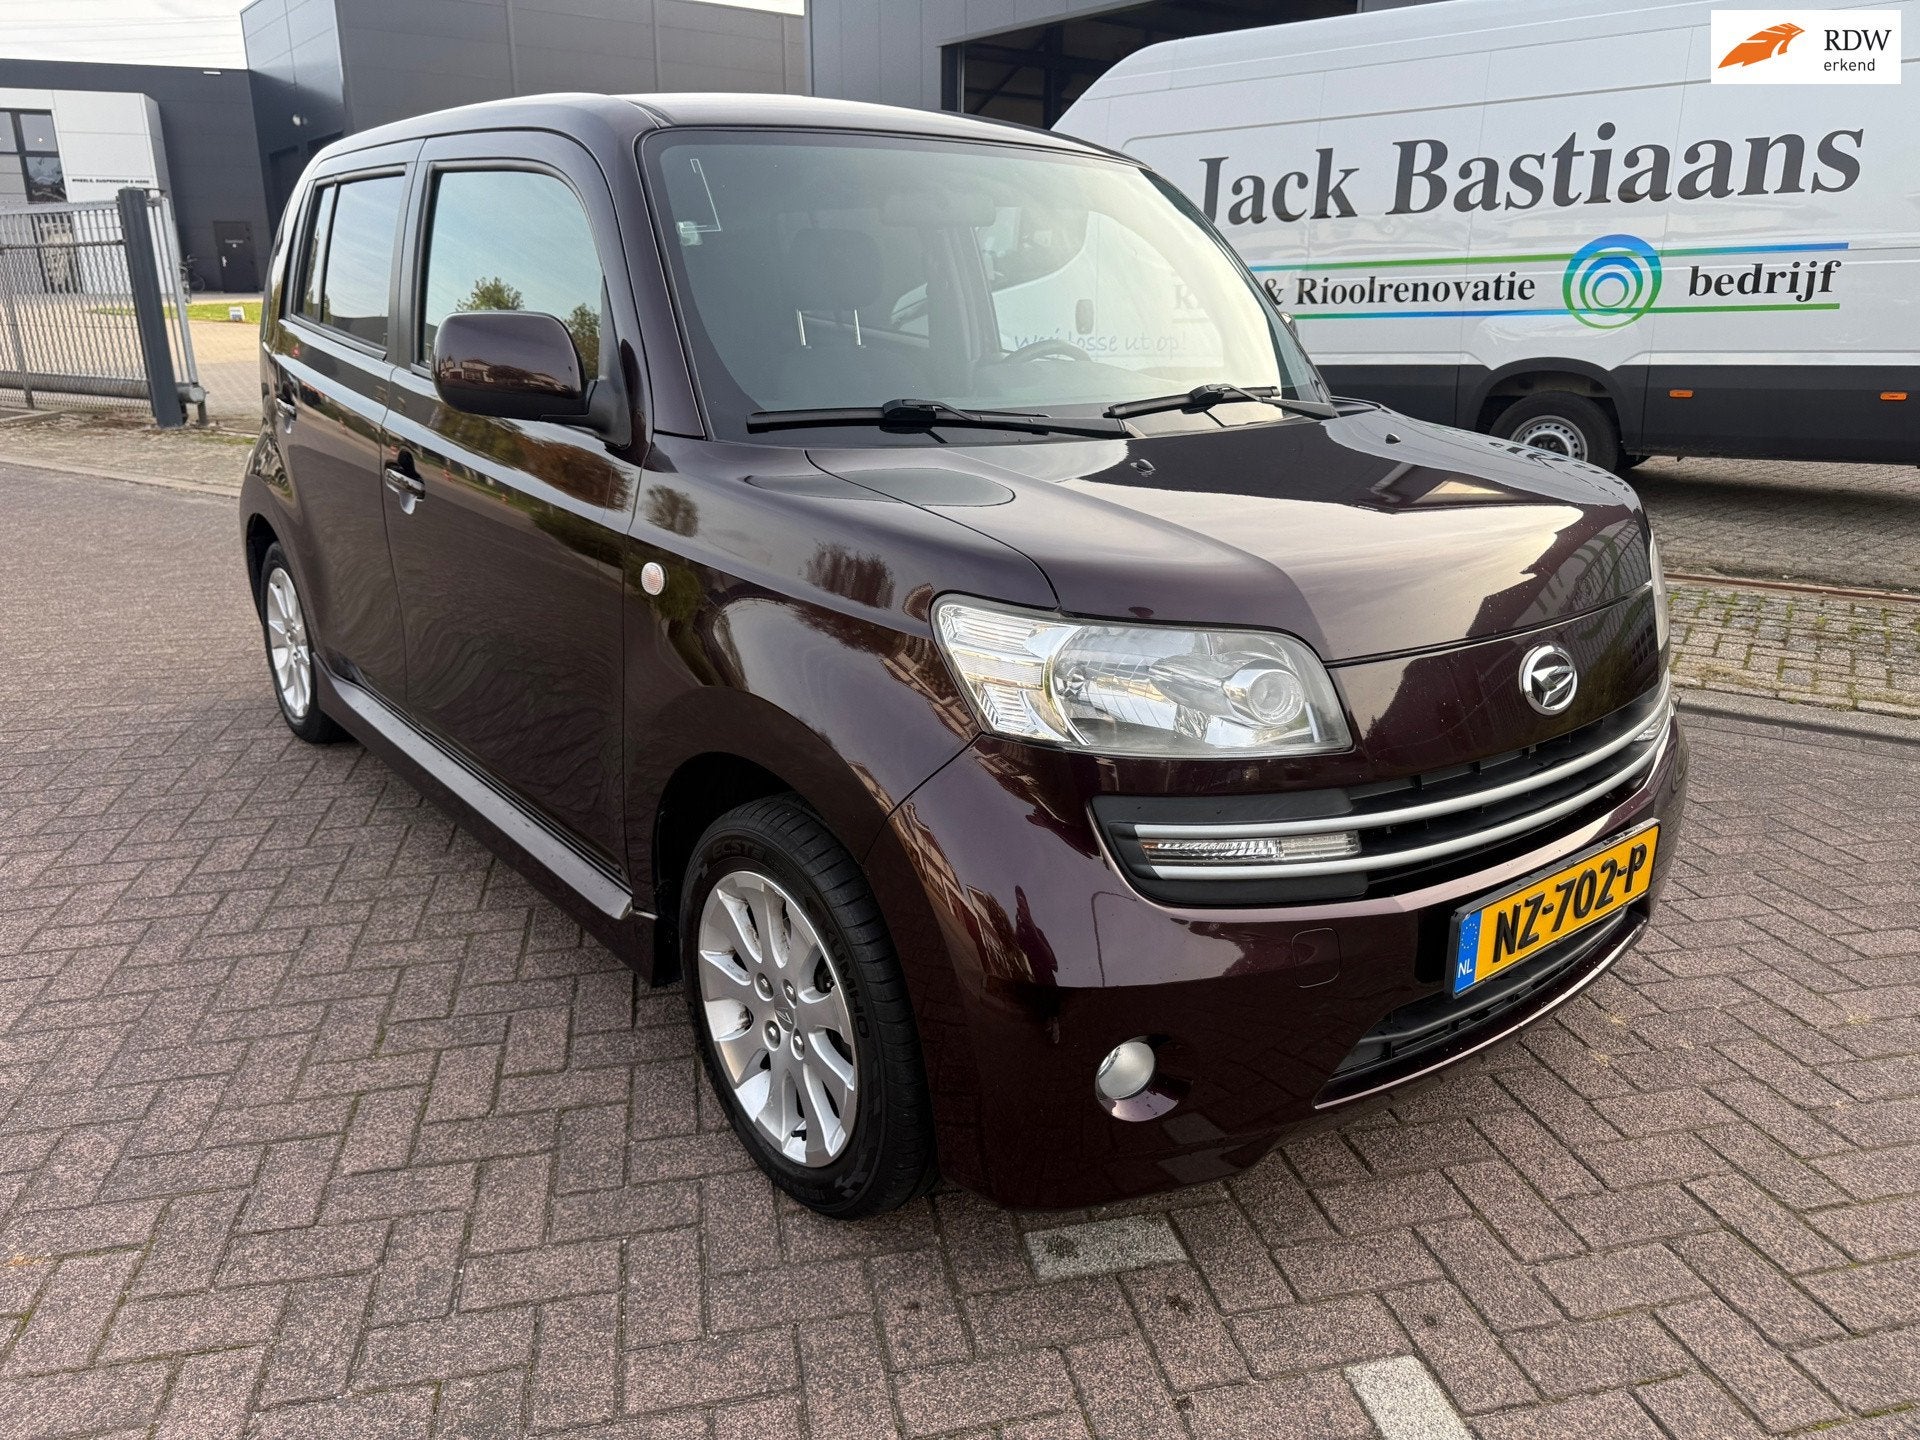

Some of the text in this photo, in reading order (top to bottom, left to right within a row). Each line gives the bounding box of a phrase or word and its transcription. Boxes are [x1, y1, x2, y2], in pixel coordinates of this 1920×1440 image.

[1199, 121, 1865, 226] Jack Bastiaans
[1264, 259, 1842, 305] & Rioolrenovatie bedrijf
[1492, 843, 1647, 963] NZ-702-P
[820, 918, 870, 1039] KUMHO
[1457, 958, 1473, 978] NL
